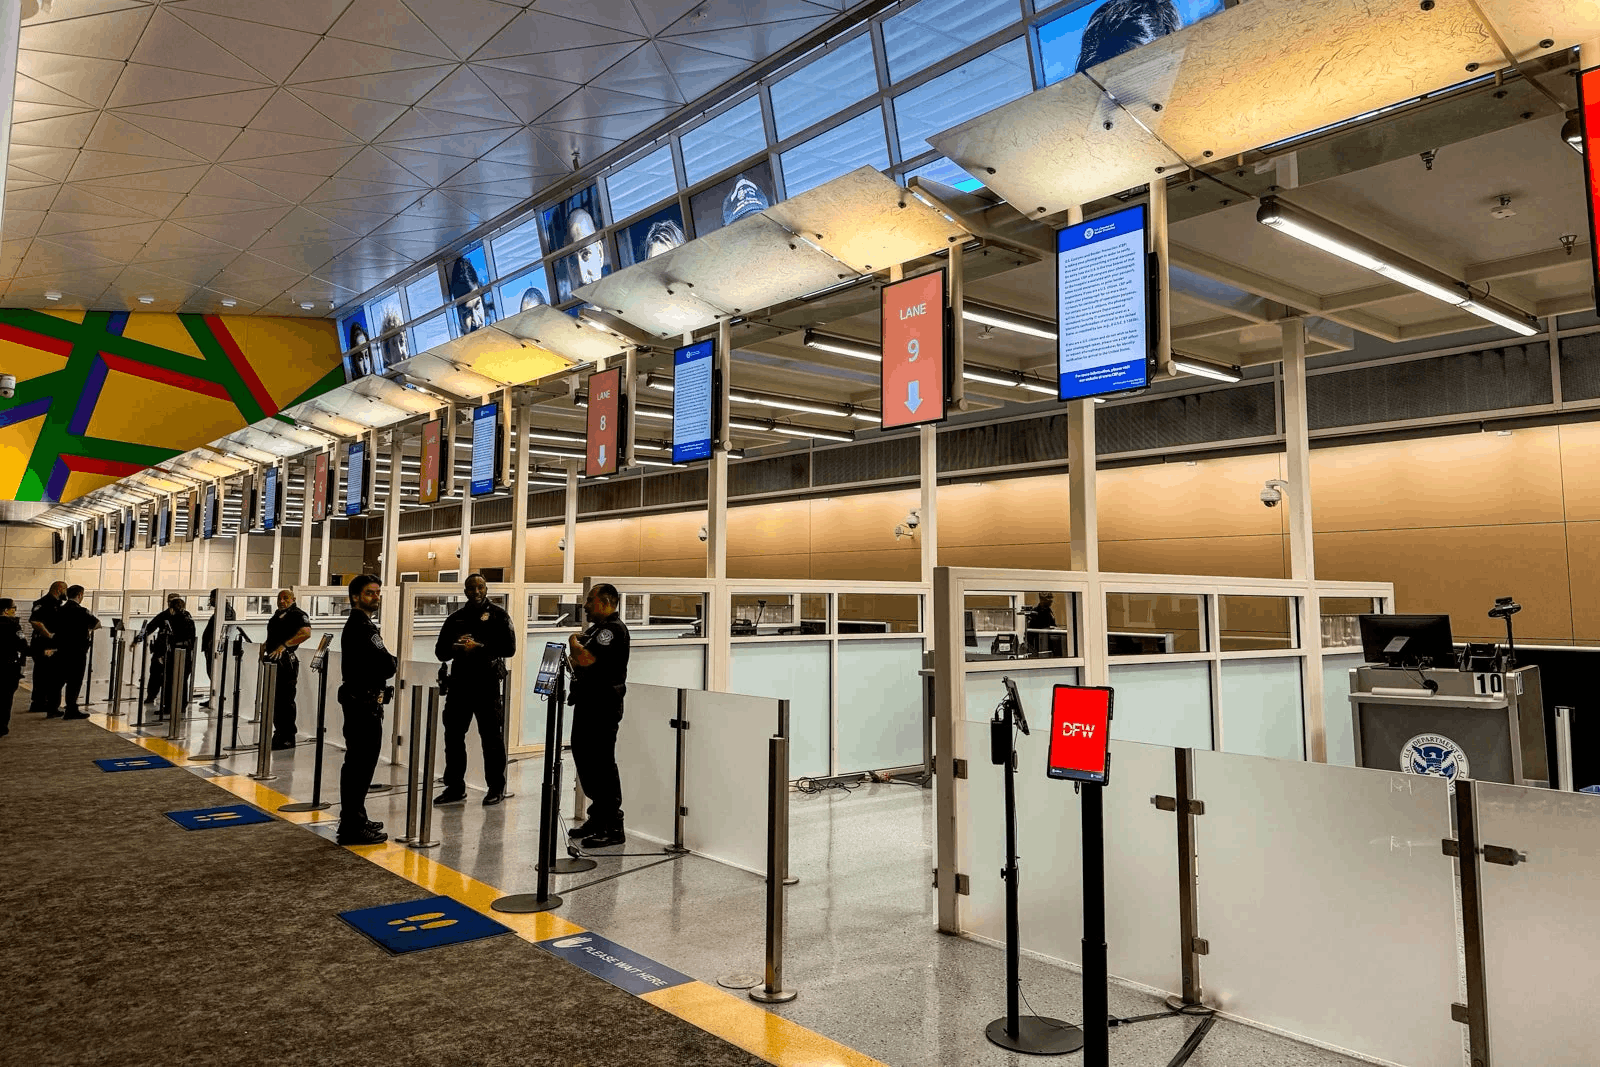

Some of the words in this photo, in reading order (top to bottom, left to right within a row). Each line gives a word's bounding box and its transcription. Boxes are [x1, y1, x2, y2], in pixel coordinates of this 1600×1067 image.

[899, 302, 928, 321] LANE
[907, 338, 920, 363] 9
[596, 389, 611, 401] LANE
[599, 415, 607, 431] 8
[1476, 673, 1502, 695] 10
[1062, 722, 1096, 739] DFW
[1412, 736, 1459, 756] DEPARTMENT
[1456, 754, 1465, 764] OF
[582, 946, 620, 964] PLEASE
[615, 960, 642, 974] WAIT
[638, 970, 668, 987] HERE
